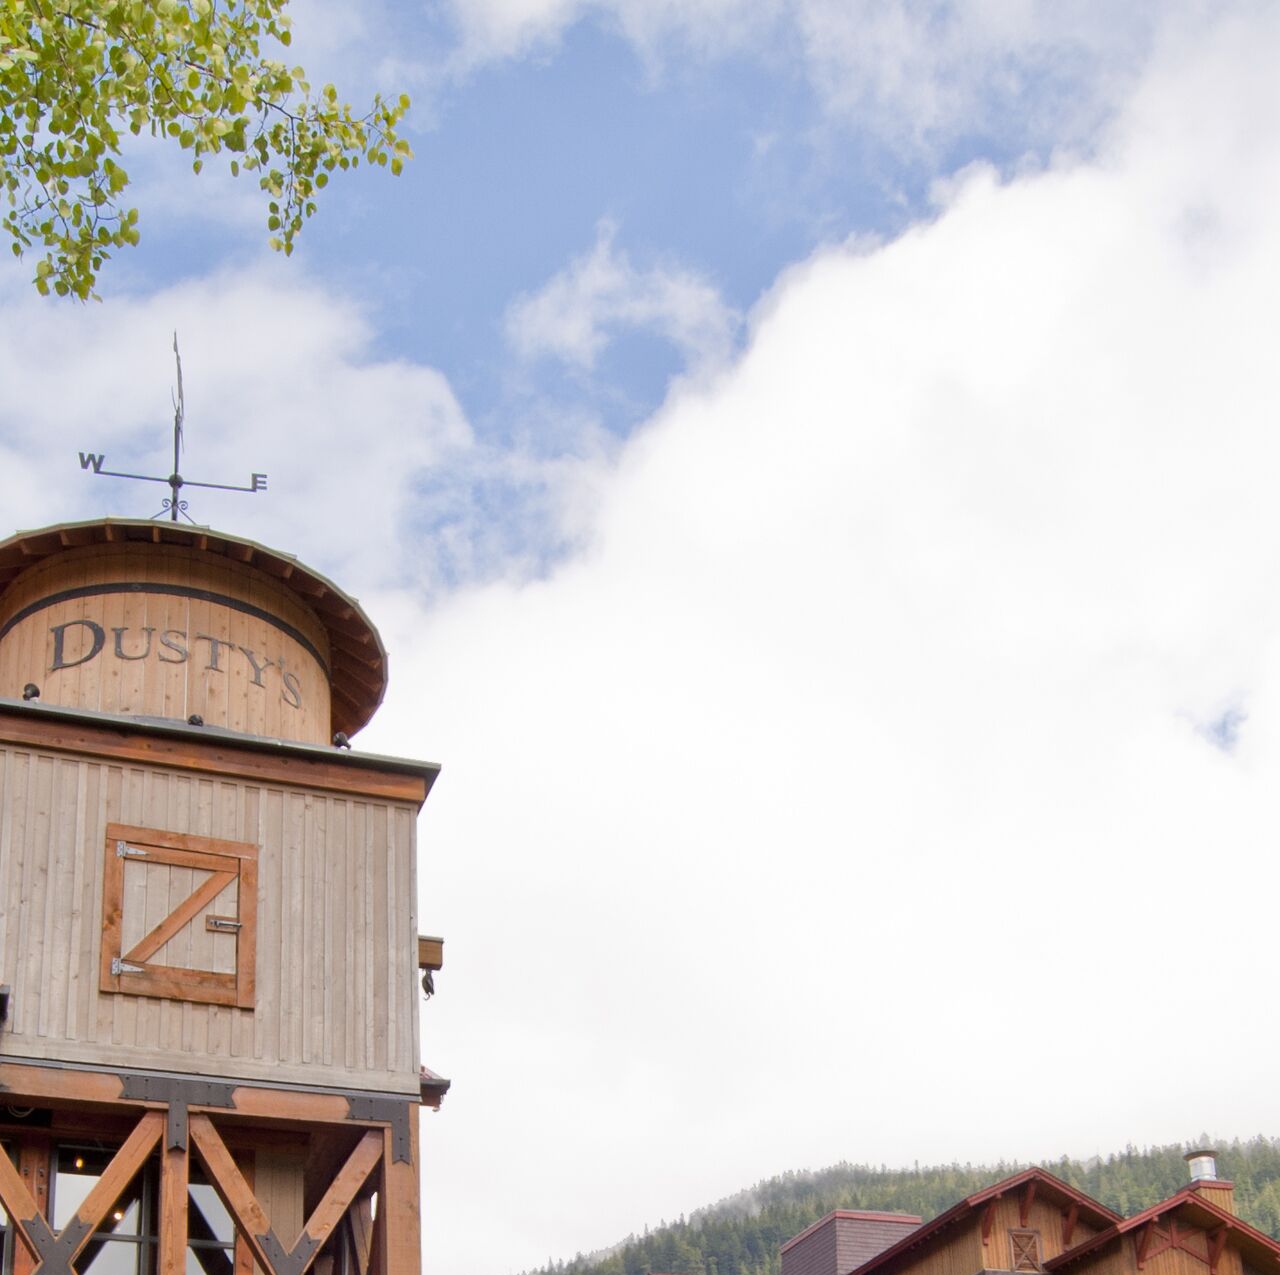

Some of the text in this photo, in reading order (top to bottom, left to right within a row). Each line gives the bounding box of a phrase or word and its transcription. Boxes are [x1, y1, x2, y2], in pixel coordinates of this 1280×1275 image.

[78, 452, 105, 473] W
[251, 473, 268, 492] E
[50, 619, 303, 709] DUSTY'S
